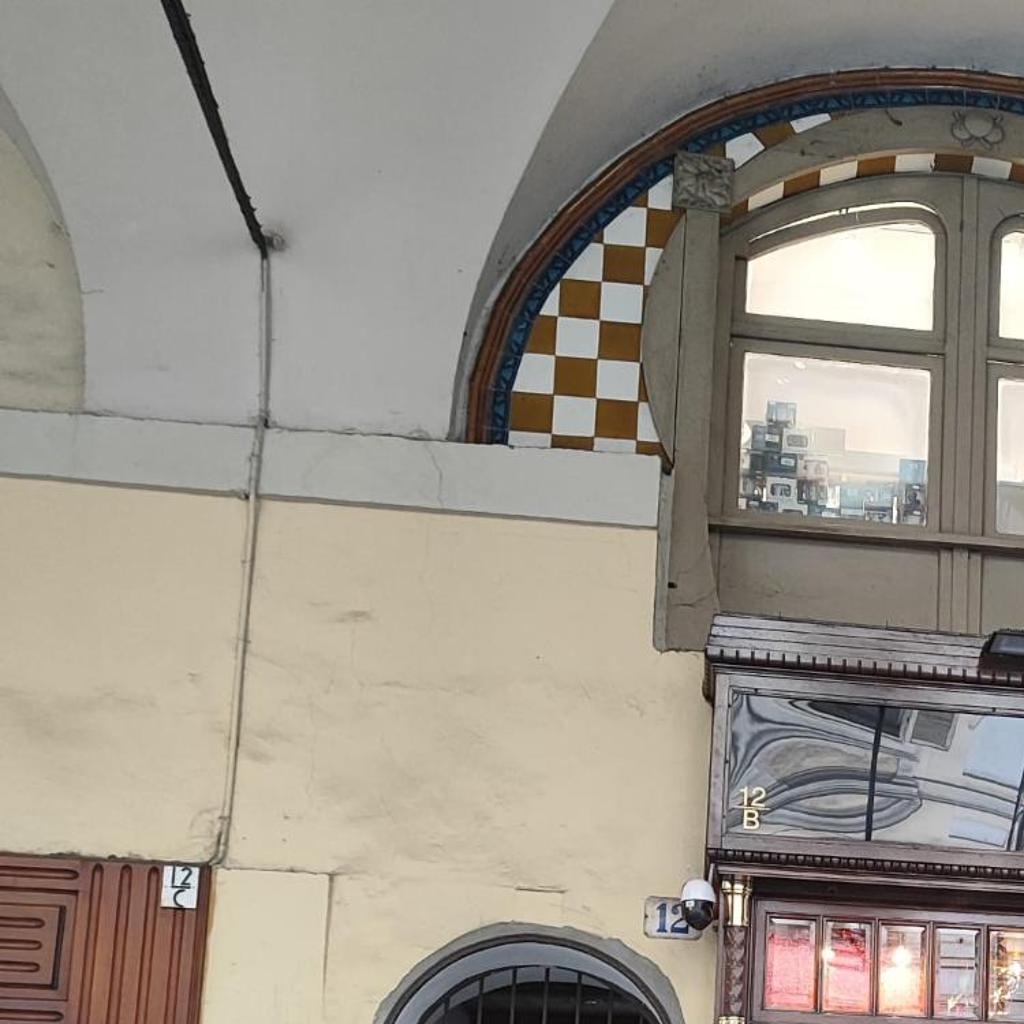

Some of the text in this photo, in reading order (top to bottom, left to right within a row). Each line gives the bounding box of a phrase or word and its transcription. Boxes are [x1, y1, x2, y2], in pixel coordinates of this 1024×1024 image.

[740, 786, 766, 807] 12
[743, 809, 760, 830] B
[173, 889, 187, 908] C
[655, 902, 689, 935] 12
